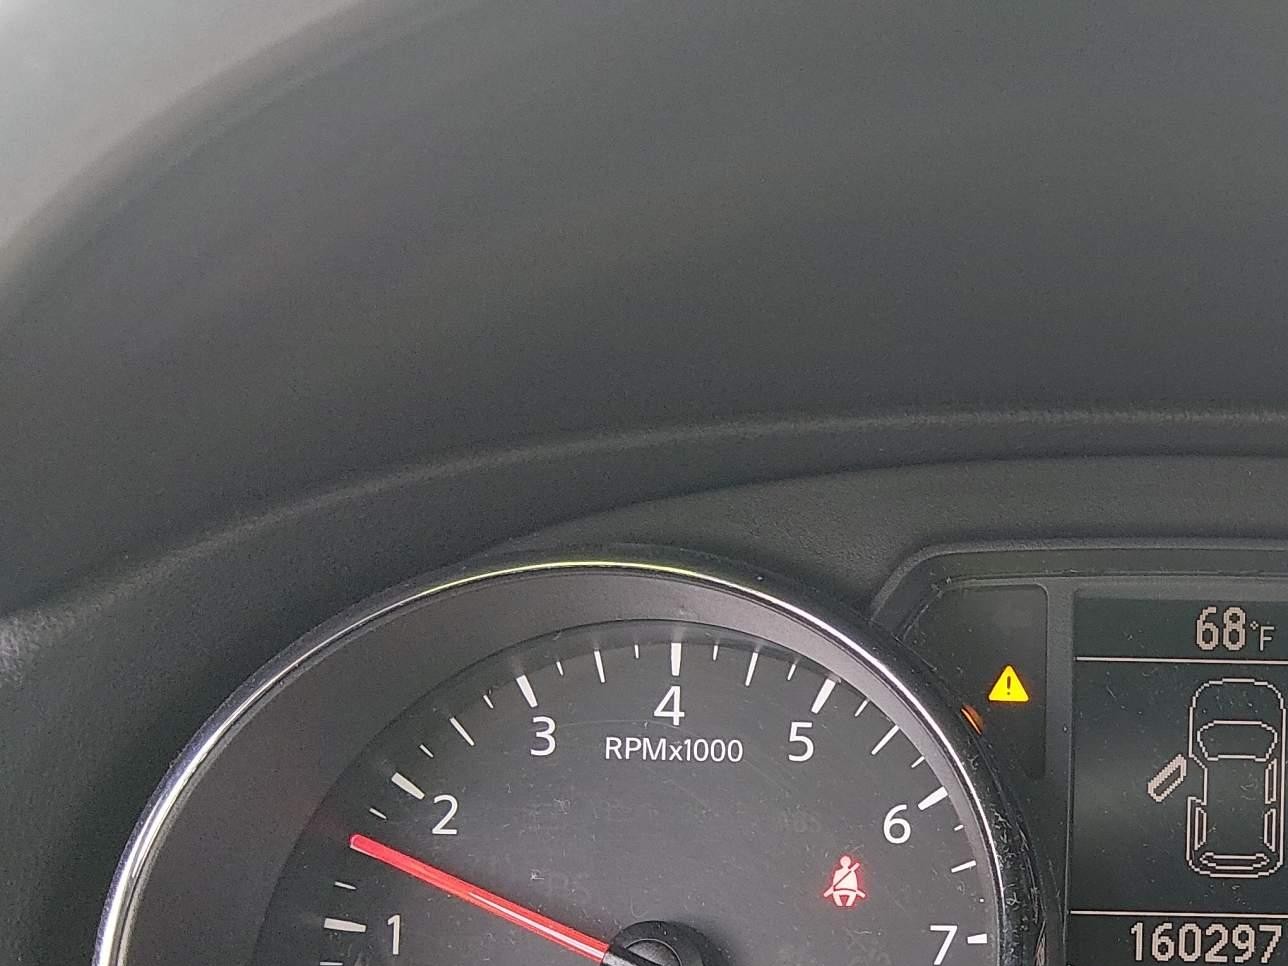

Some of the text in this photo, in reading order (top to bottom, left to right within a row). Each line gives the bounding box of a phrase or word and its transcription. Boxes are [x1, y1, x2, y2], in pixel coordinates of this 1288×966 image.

[653, 685, 685, 726] 4
[530, 716, 556, 756] 3
[605, 736, 743, 762] RPMx1000
[788, 721, 814, 762] 5
[432, 794, 458, 835] 2
[883, 804, 911, 844] 6
[387, 914, 400, 955] 1
[930, 925, 958, 966] 7
[1130, 922, 1282, 964] 160297
